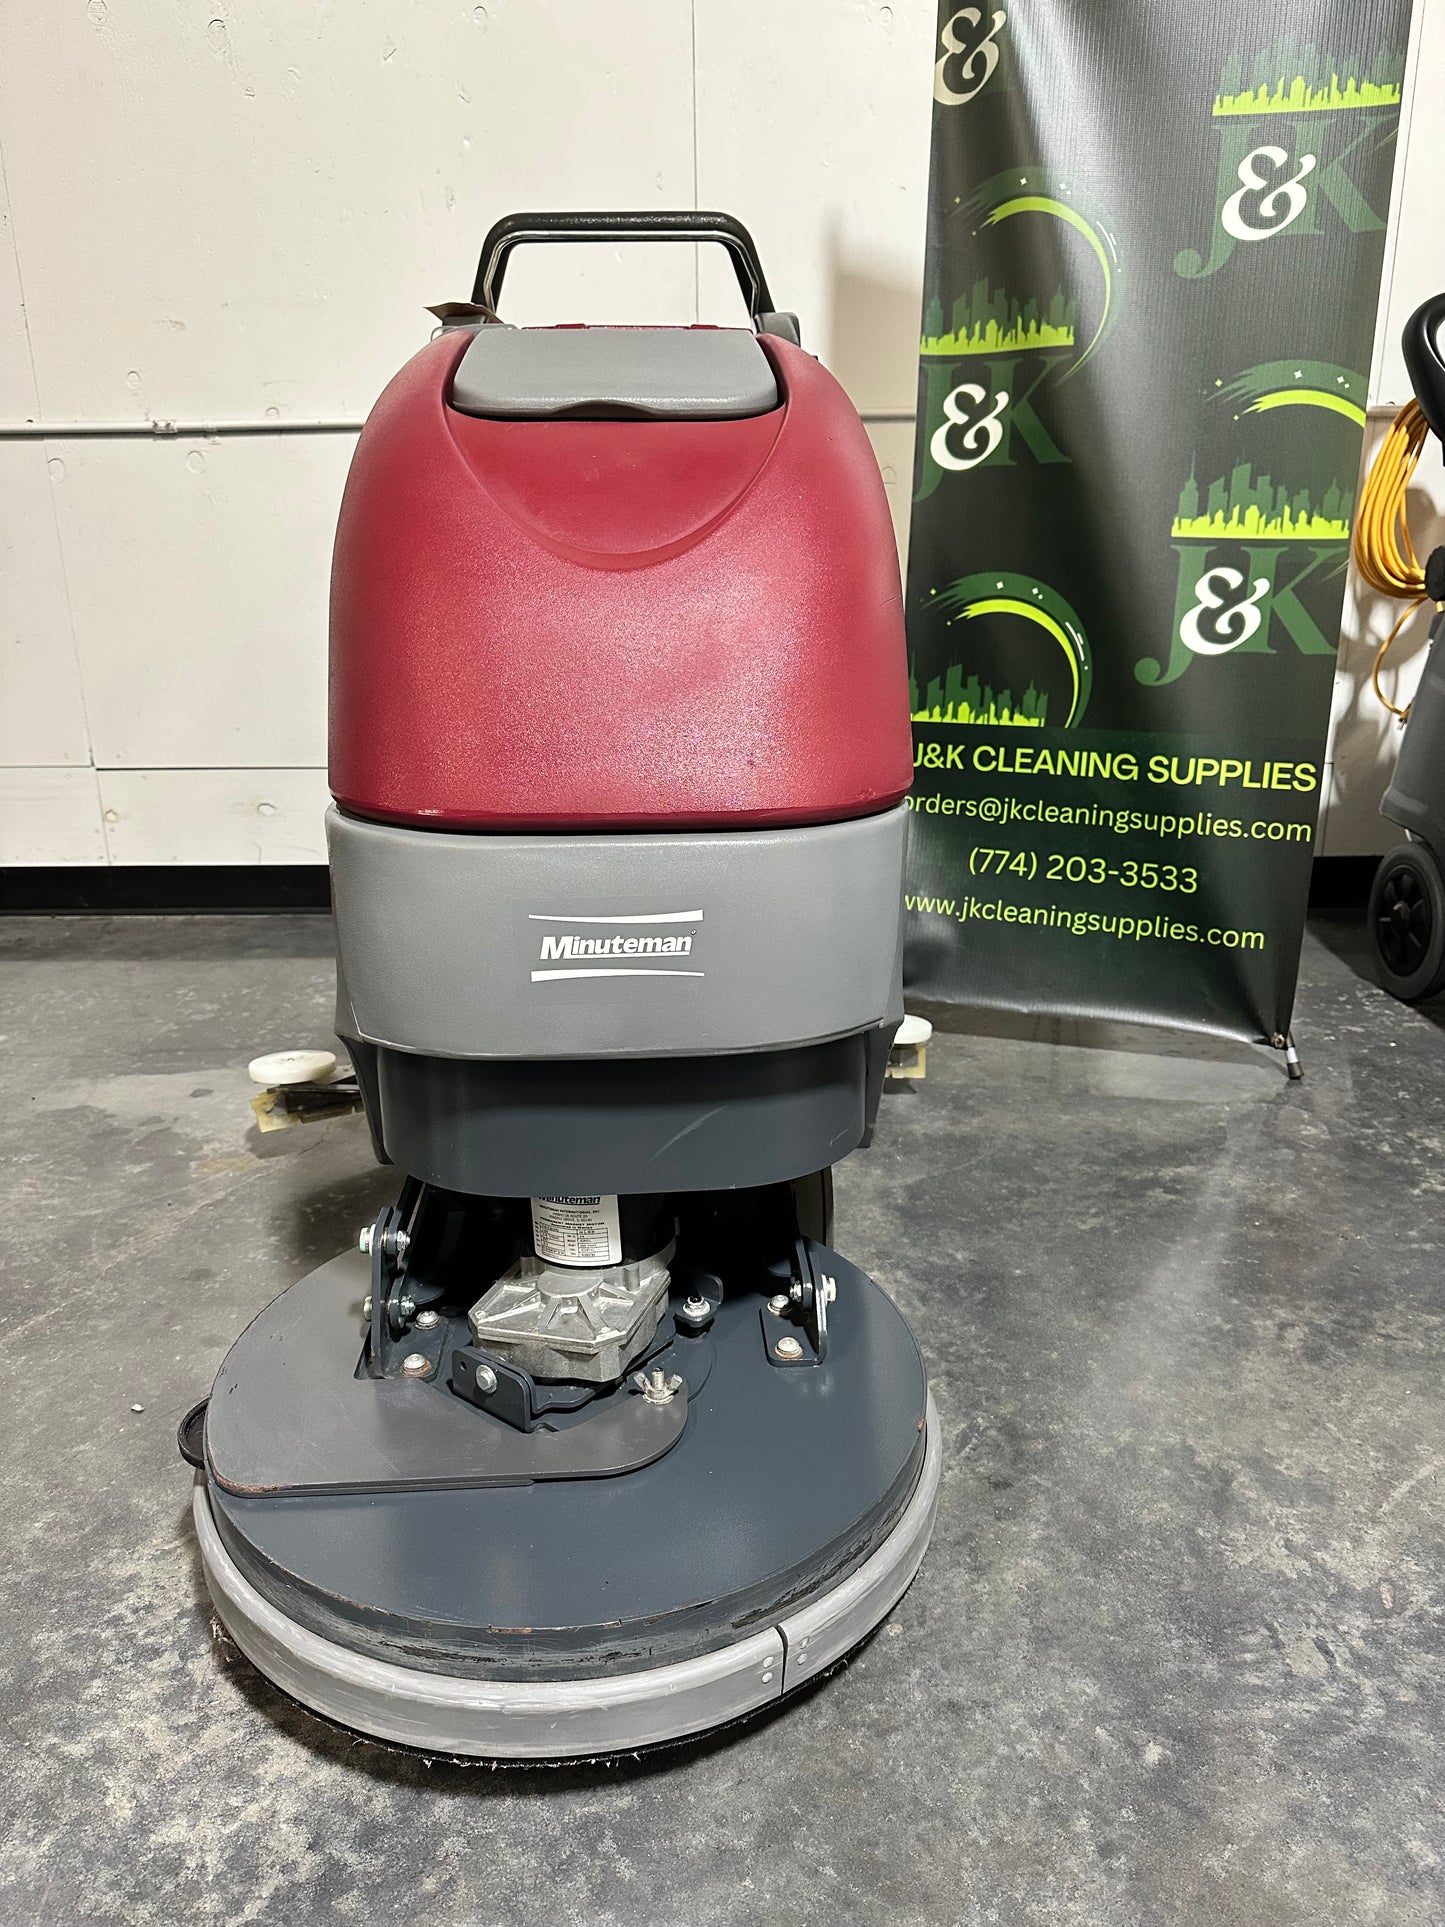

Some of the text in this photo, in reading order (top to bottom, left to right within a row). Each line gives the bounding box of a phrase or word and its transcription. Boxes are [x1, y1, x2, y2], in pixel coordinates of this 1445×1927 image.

[913, 743, 1317, 792] J&K CLEANING SUPPLIES
[969, 847, 1199, 894] (774) 203-3533
[540, 935, 693, 960] Minuteman
